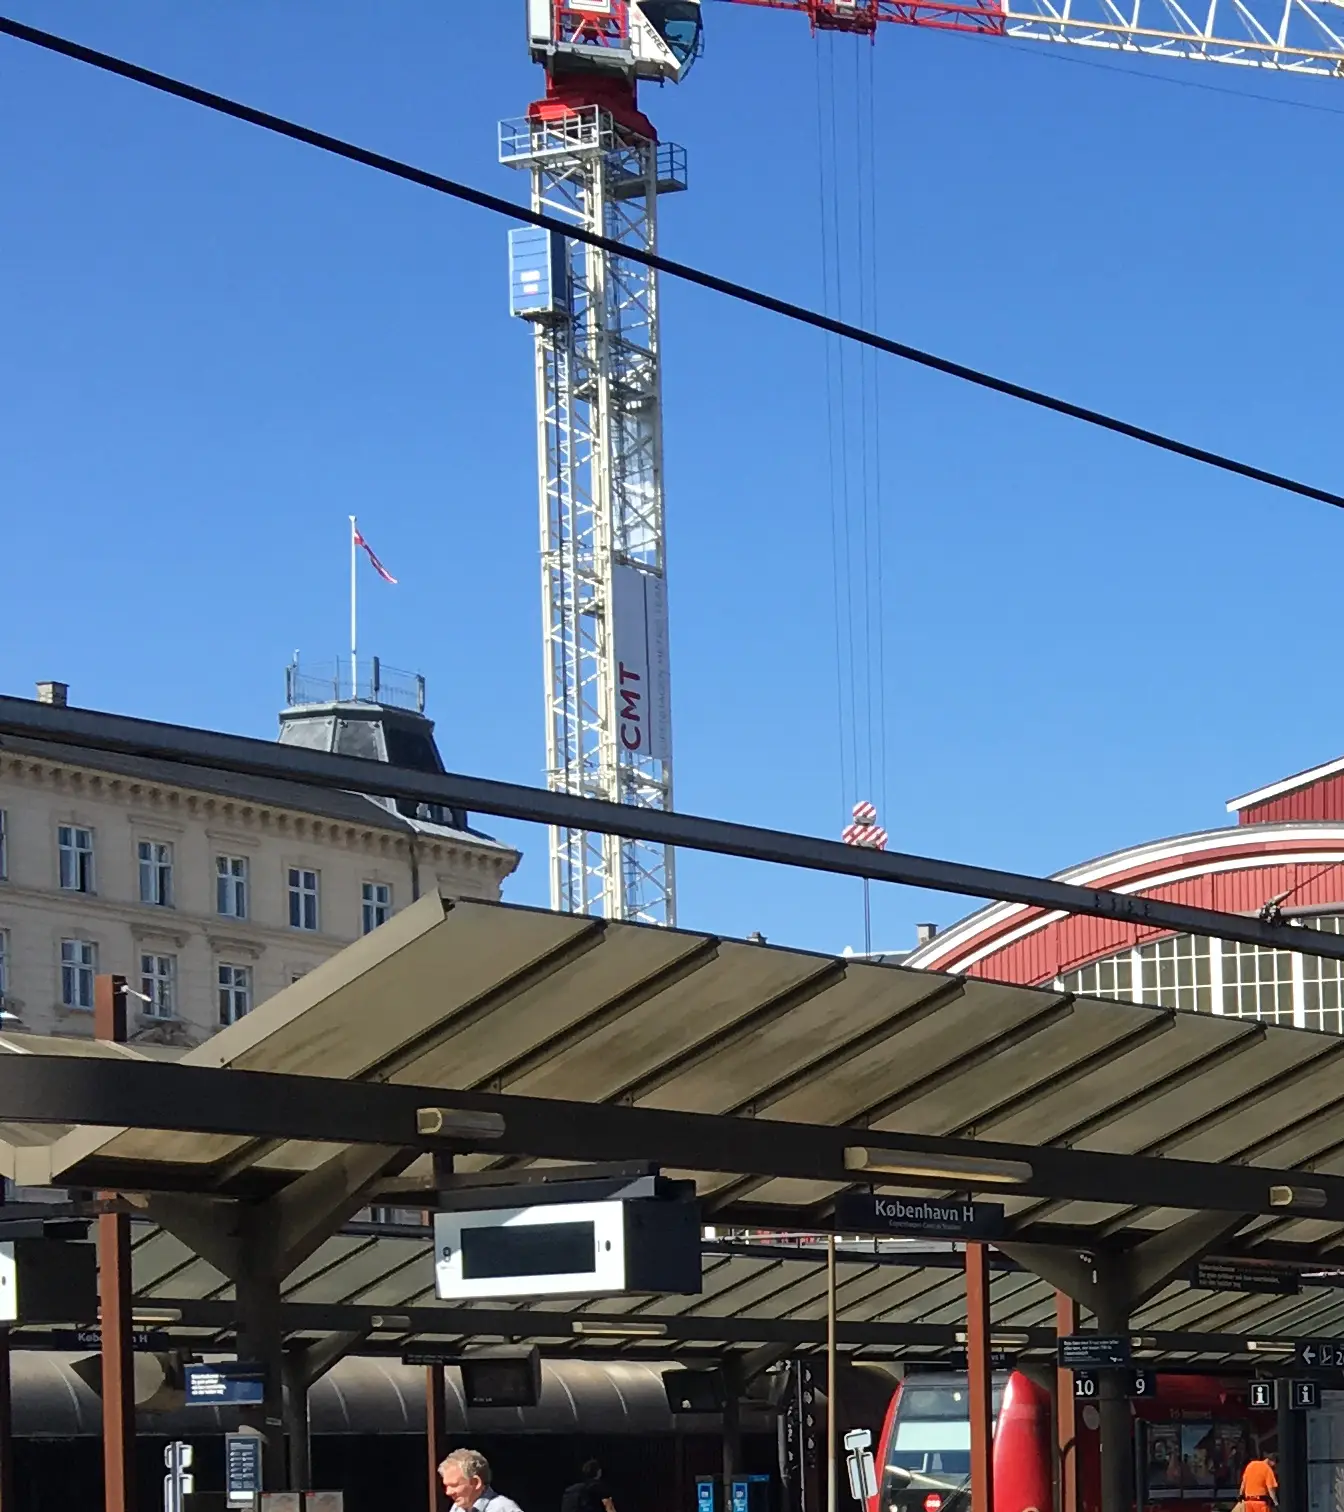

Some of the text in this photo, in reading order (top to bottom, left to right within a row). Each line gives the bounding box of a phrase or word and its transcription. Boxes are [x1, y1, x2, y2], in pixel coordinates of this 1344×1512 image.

[643, 22, 670, 56] TEREX
[619, 661, 641, 750] CMT
[875, 1199, 975, 1222] København H
[1075, 1380, 1095, 1396] 10
[1135, 1379, 1146, 1395] 9
